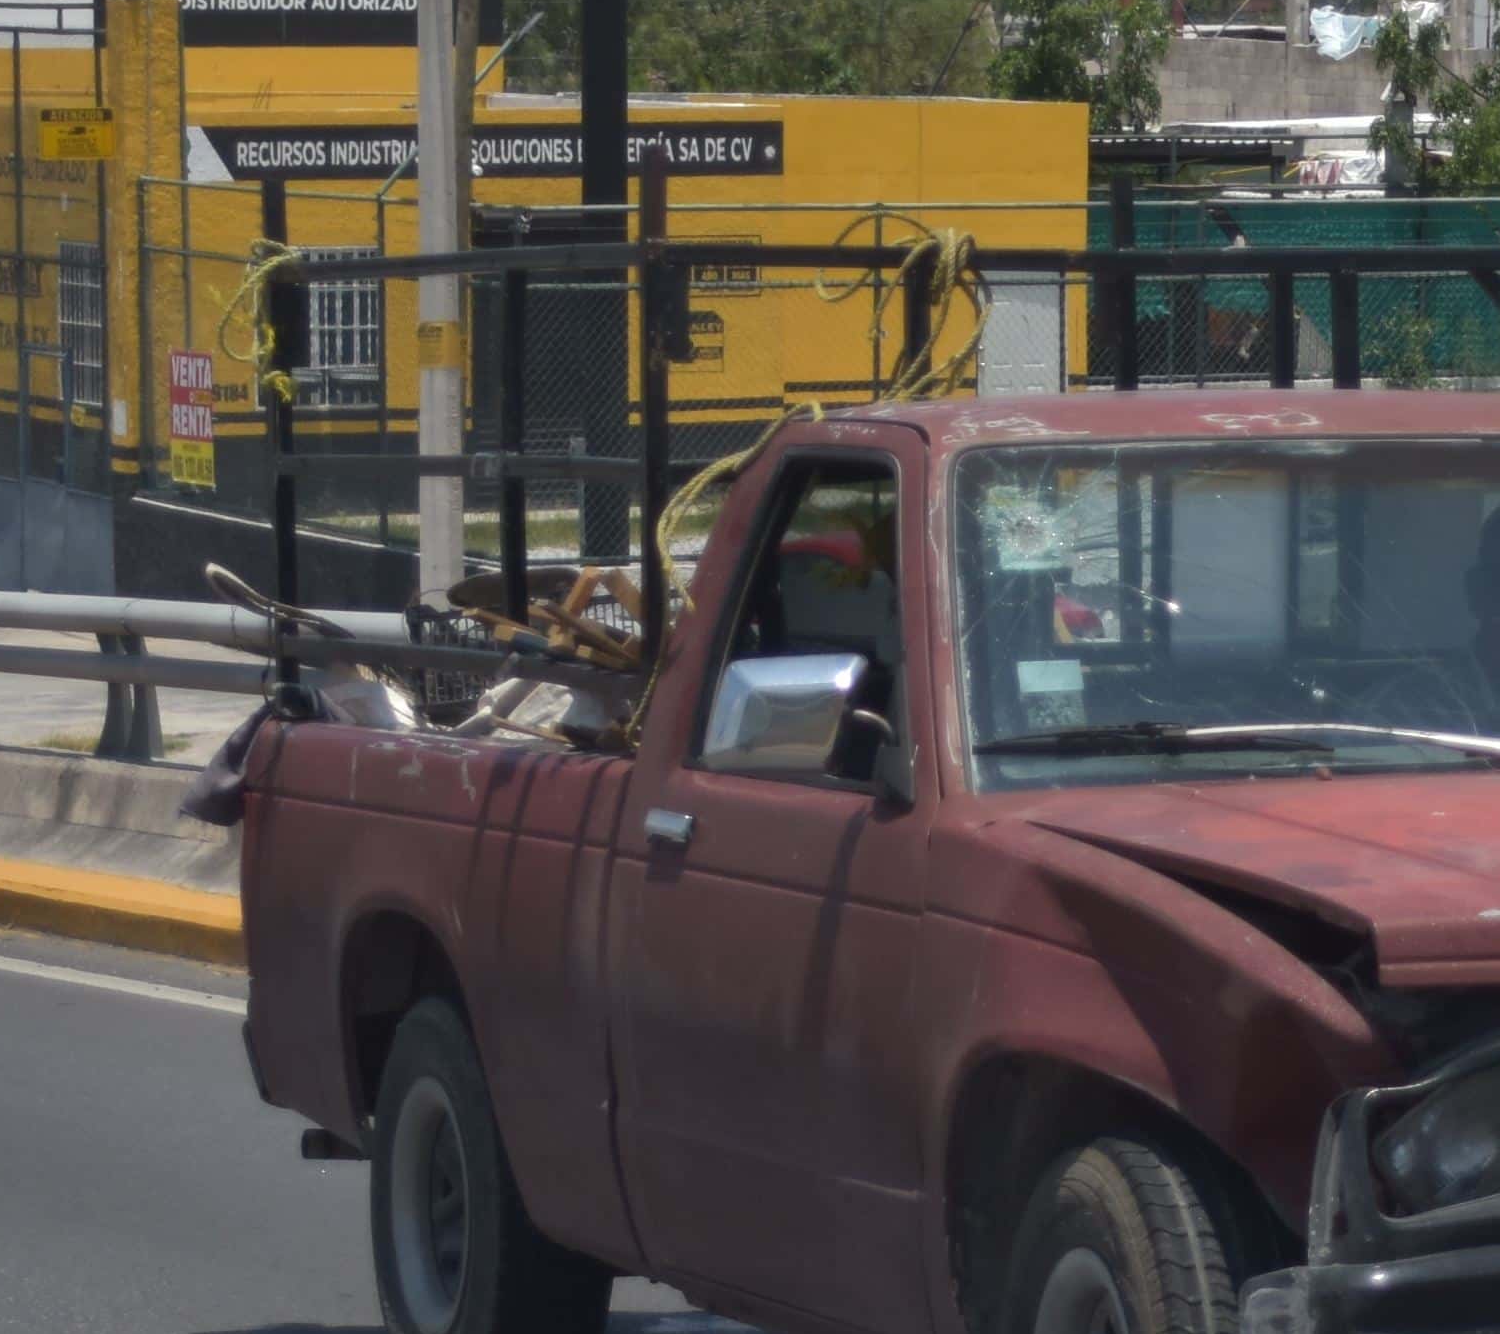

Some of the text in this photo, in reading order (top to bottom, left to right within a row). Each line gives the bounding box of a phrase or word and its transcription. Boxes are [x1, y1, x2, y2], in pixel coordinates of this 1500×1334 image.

[236, 140, 326, 167] RECURSOS
[678, 137, 700, 163] SA
[704, 137, 727, 163] DE
[730, 136, 753, 162] CV
[171, 354, 213, 390] VENTA
[172, 404, 213, 438] RENTA
